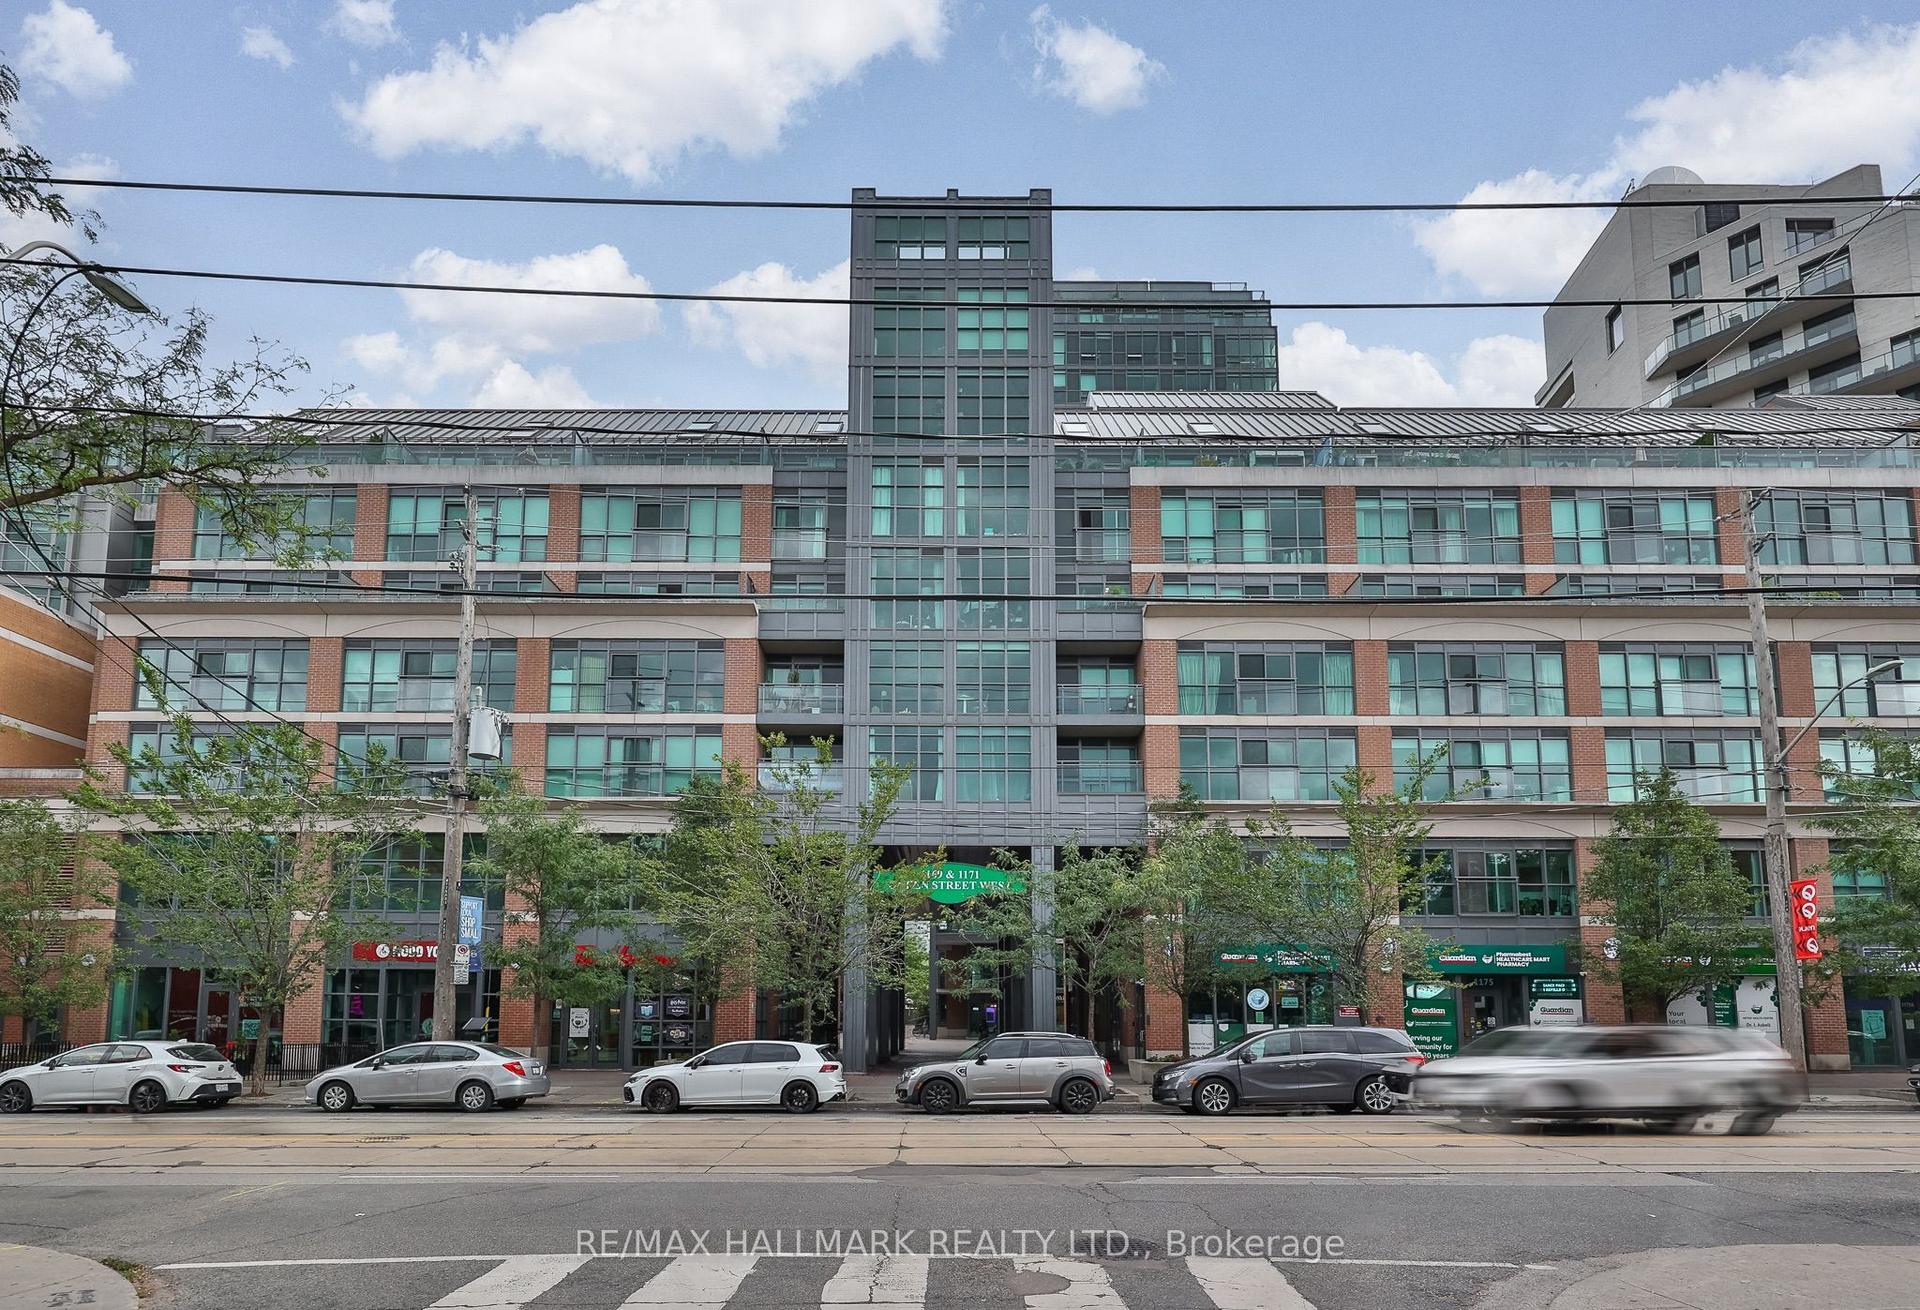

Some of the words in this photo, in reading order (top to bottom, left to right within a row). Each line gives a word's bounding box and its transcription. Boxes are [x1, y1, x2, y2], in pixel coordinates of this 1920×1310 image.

[923, 870, 942, 879] 169
[946, 870, 955, 879] &
[959, 870, 979, 879] 1171
[932, 880, 977, 890] STREET
[461, 917, 476, 928] SHOP
[1409, 1034, 1431, 1042] erving
[1415, 1043, 1442, 1052] mmunity
